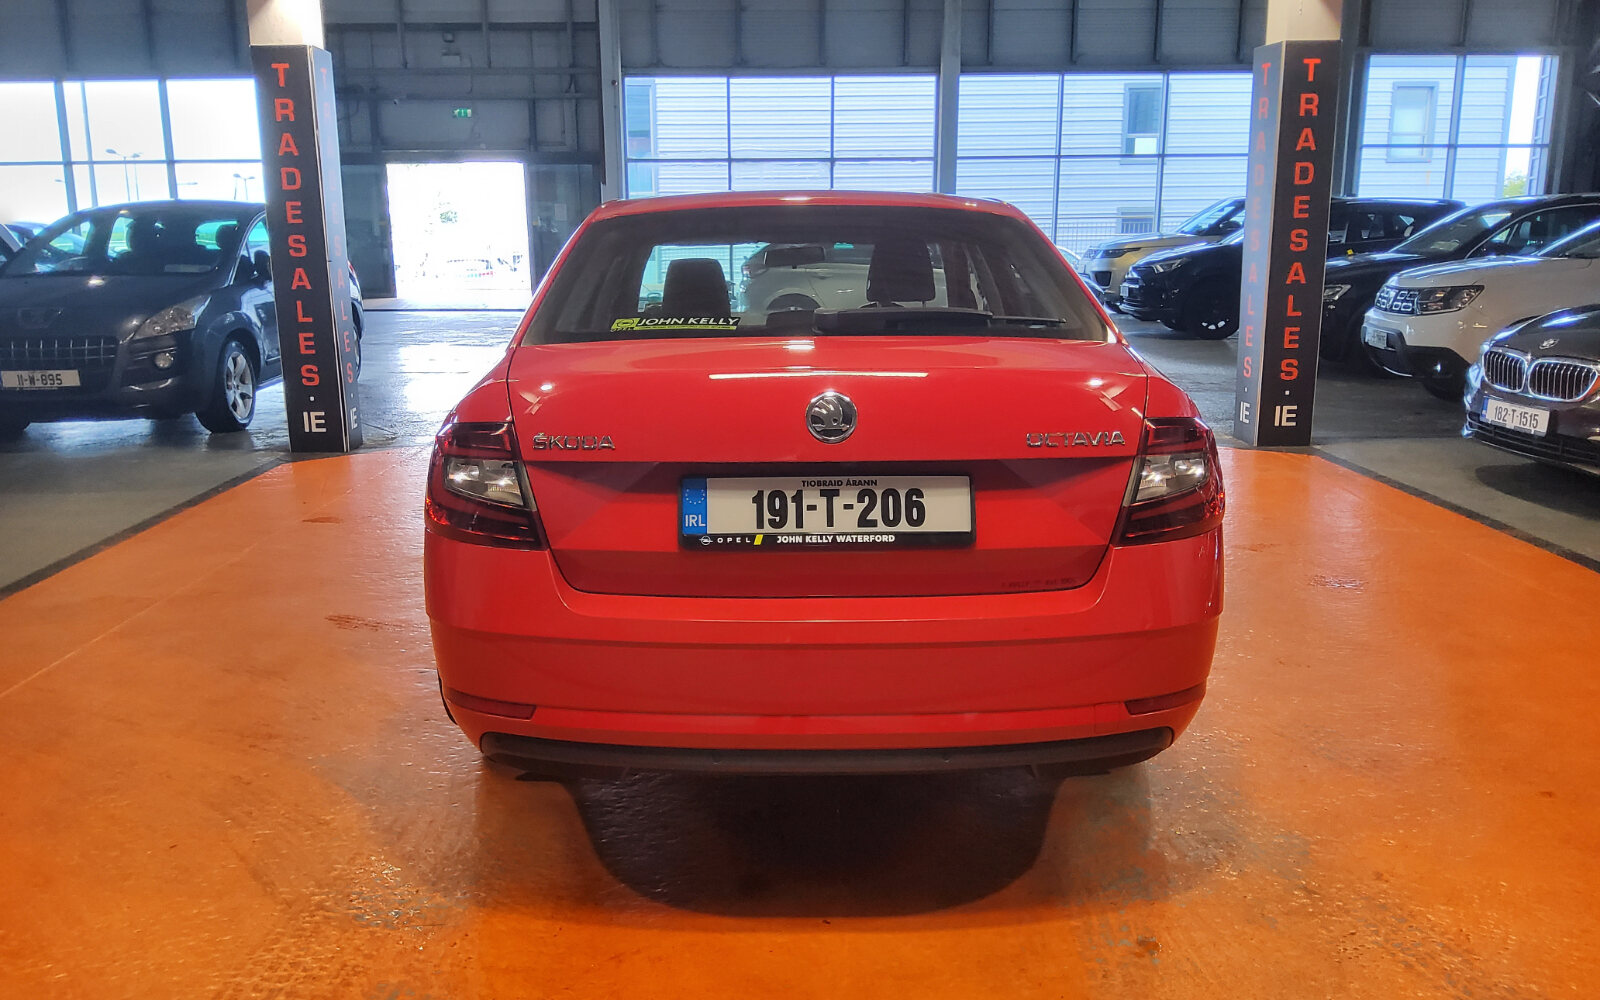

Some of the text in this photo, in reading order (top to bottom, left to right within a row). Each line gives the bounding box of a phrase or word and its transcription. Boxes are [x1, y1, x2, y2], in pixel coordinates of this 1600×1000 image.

[637, 317, 740, 326] JOHN KELLY
[1494, 405, 1540, 429] 182-T-1515
[1026, 430, 1126, 448] OCTAVIA
[802, 480, 844, 488] TIOBRAID
[751, 487, 926, 530] 191-T-206
[684, 514, 707, 527] IRL
[717, 535, 896, 544] OPEL JOHN KELLY WATERFORD
